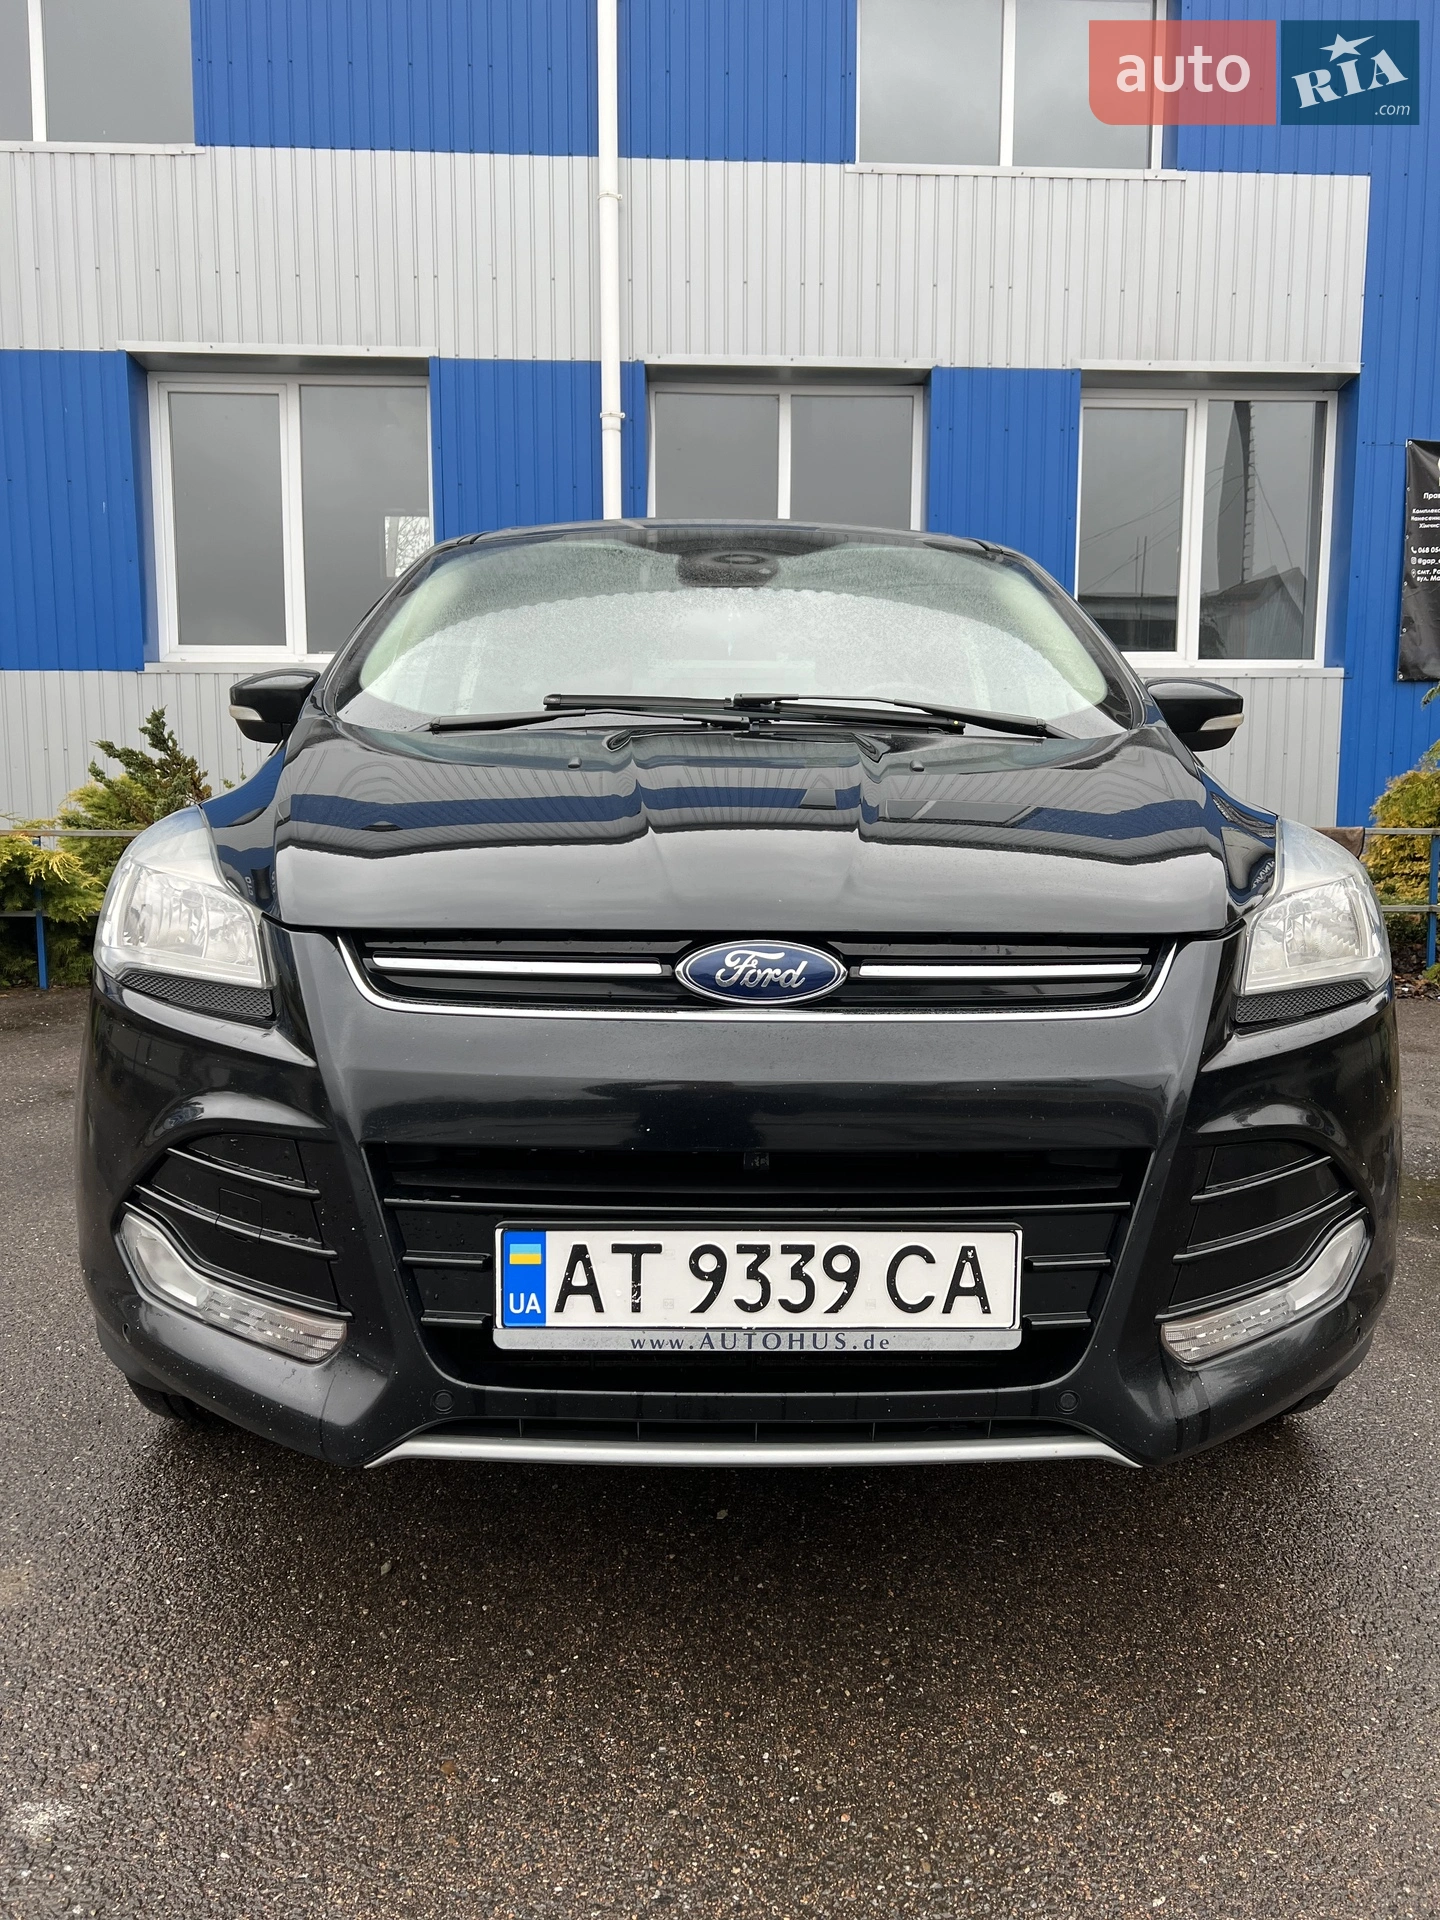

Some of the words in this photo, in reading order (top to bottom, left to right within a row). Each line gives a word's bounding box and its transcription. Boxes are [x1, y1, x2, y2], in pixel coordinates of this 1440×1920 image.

[715, 949, 808, 988] Ford
[554, 1243, 663, 1314] AT
[688, 1243, 860, 1314] 9339
[887, 1245, 992, 1314] CA
[509, 1292, 542, 1314] UA
[631, 1332, 890, 1350] www.AUTOHUS.de
